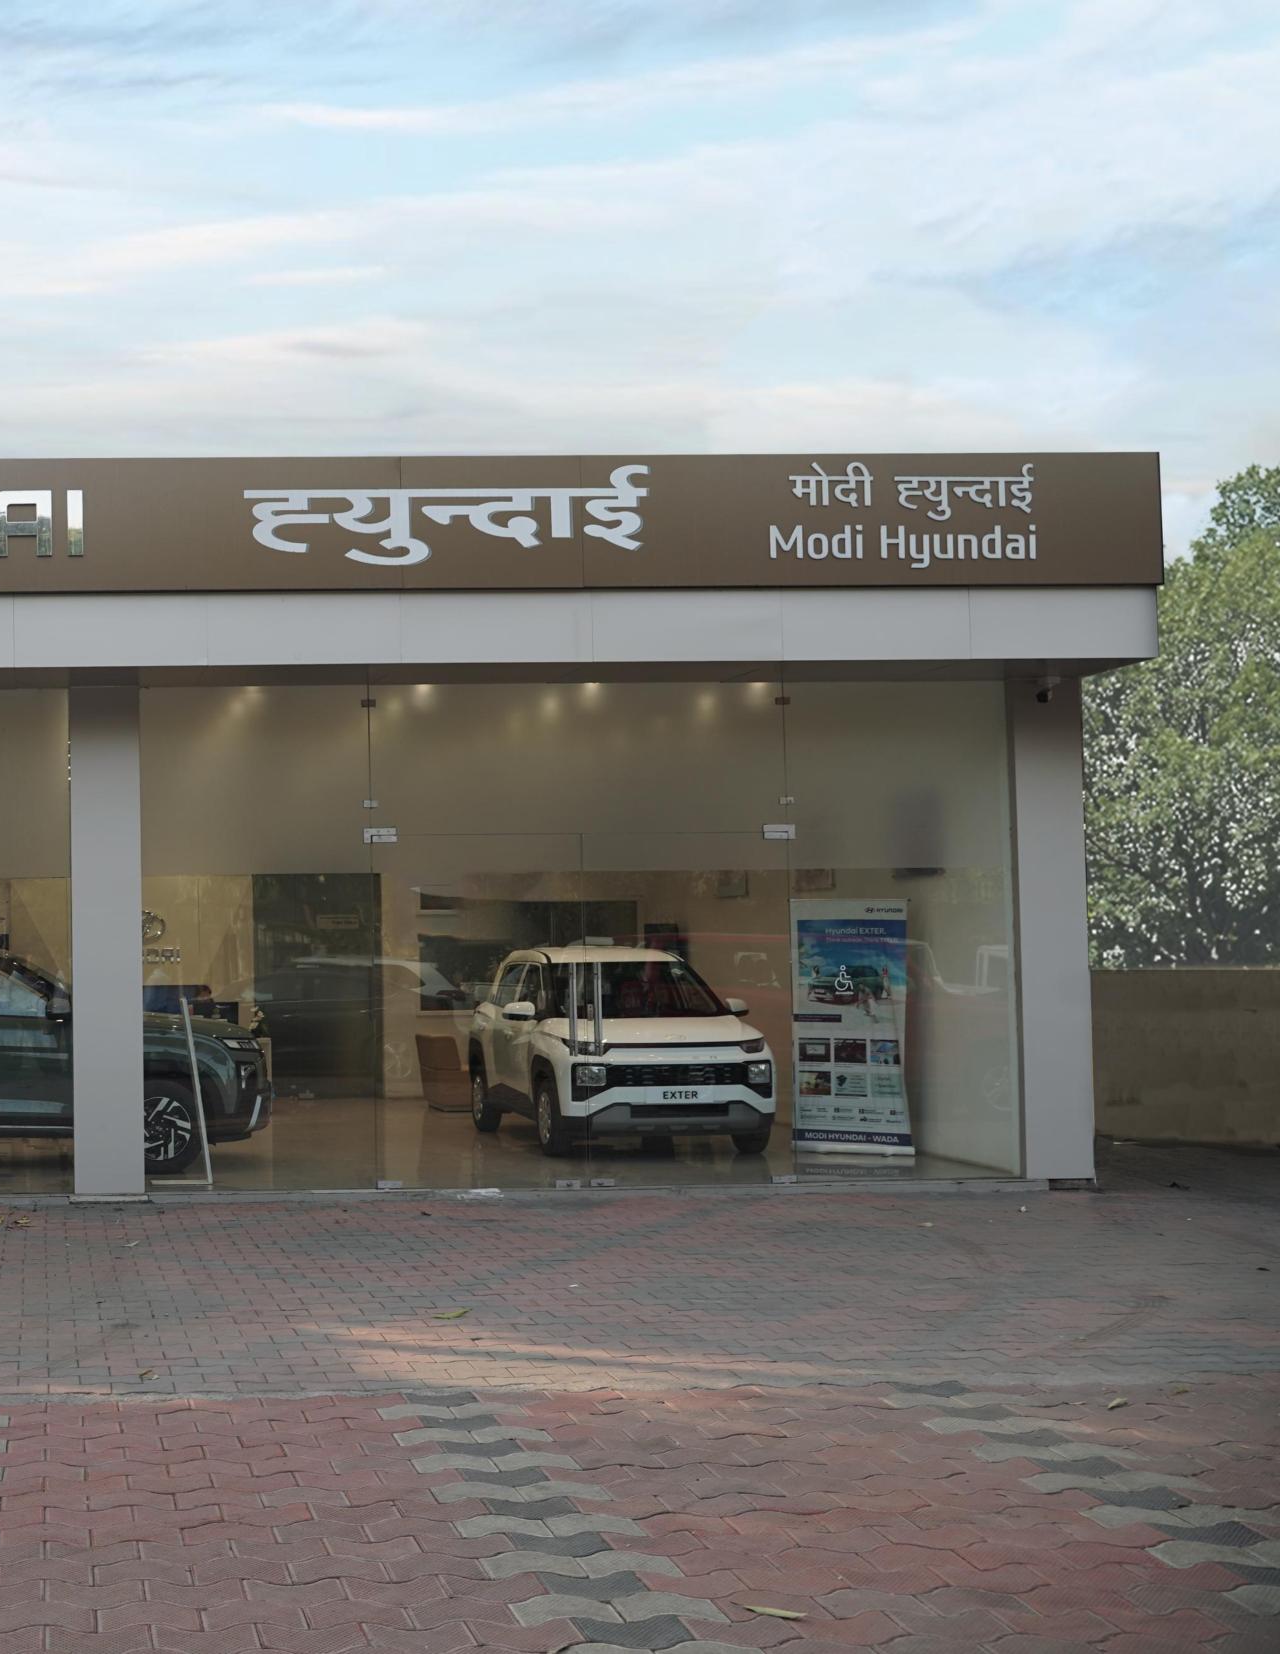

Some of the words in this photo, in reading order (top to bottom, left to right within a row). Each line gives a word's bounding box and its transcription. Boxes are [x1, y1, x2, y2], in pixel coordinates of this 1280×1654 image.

[789, 462, 873, 508] मोदी
[769, 524, 864, 560] Modi
[880, 524, 1037, 569] Hyundai
[825, 927, 858, 936] Hyundai
[662, 1090, 699, 1100] EXTER
[804, 1131, 827, 1139] MODI
[828, 1133, 866, 1141] HYUNDAI
[872, 1135, 899, 1143] WADA
